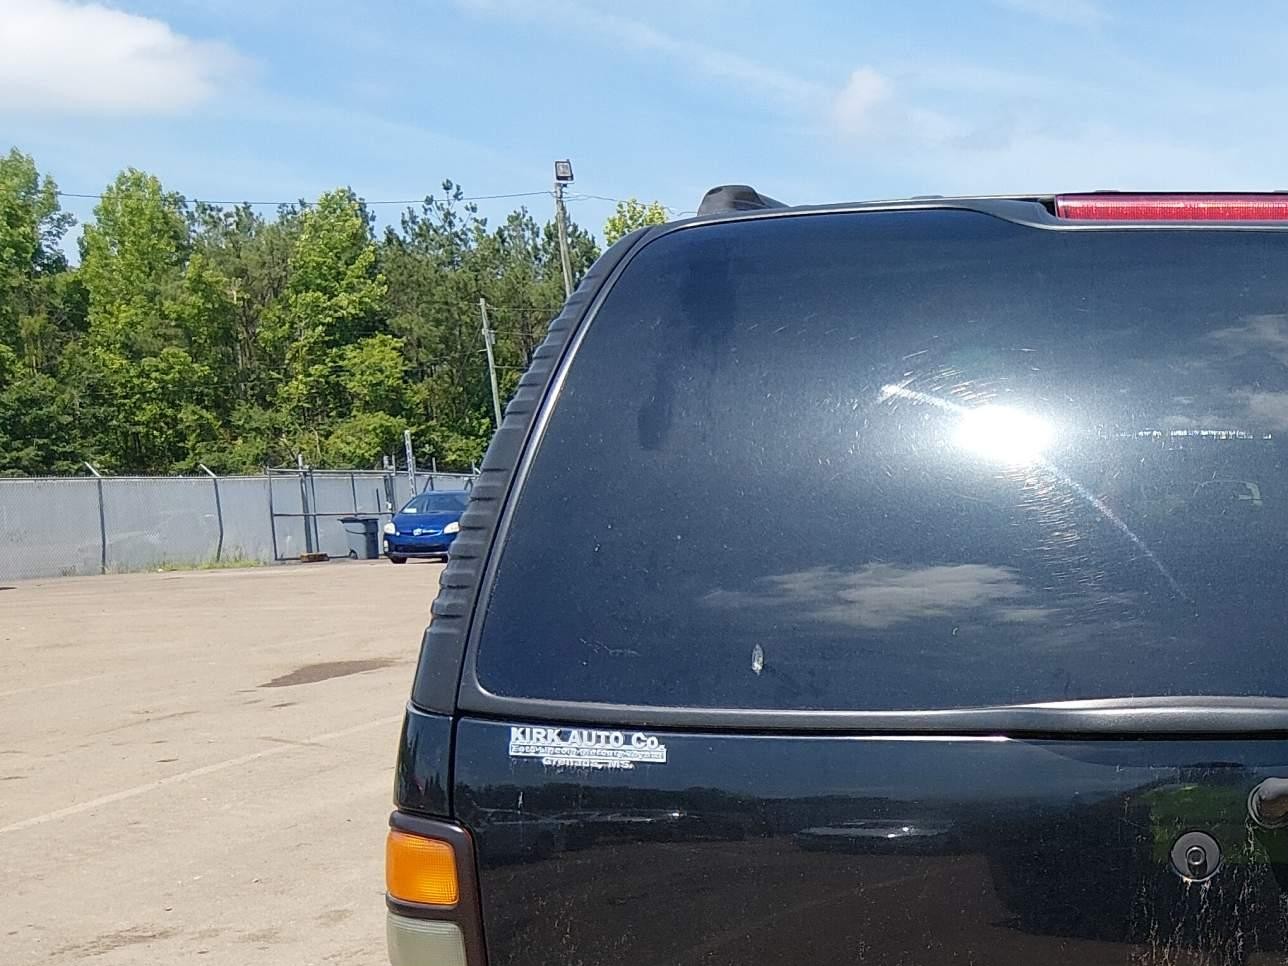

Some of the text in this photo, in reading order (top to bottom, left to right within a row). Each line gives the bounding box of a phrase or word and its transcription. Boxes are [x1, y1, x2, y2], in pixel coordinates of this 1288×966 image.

[510, 727, 666, 750] KIRK AUTO Co.
